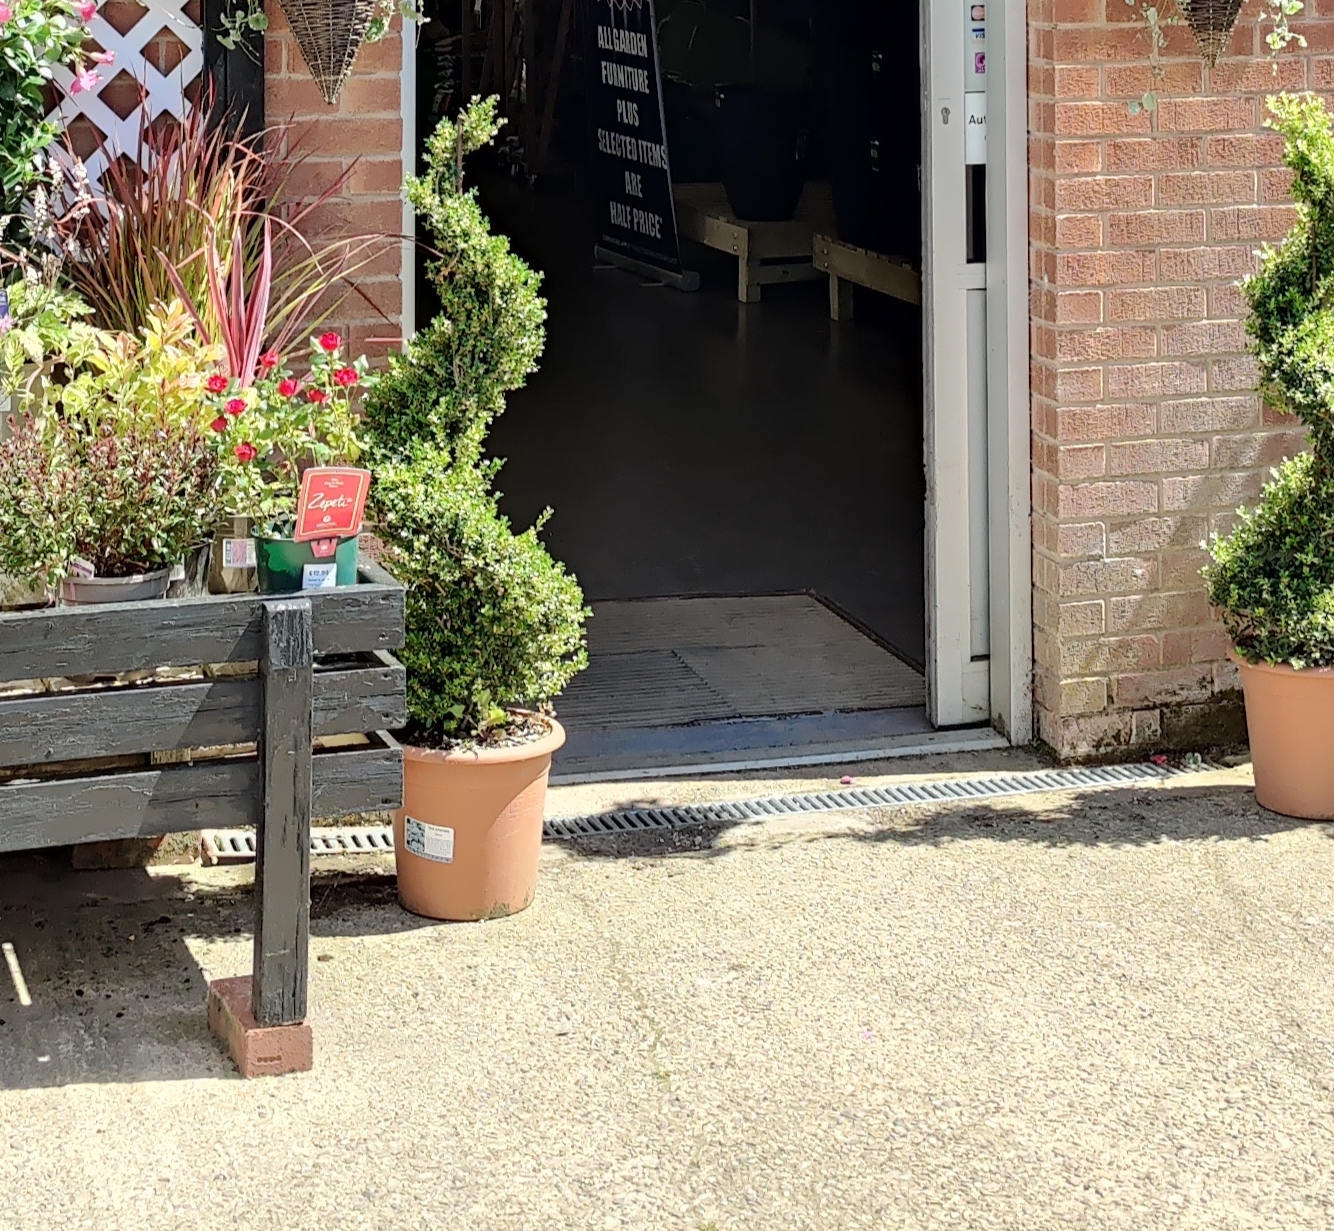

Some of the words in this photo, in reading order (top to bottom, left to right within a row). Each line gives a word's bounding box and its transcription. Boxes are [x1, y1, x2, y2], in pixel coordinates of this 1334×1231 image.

[597, 25, 613, 51] ALL
[613, 27, 648, 58] GARDEN
[600, 60, 650, 94] FURNITURE
[617, 98, 639, 128] PLUS
[597, 127, 637, 162] SELECTED
[638, 139, 668, 170] ITEMS
[624, 170, 643, 199] ARE
[609, 200, 631, 230] HALF
